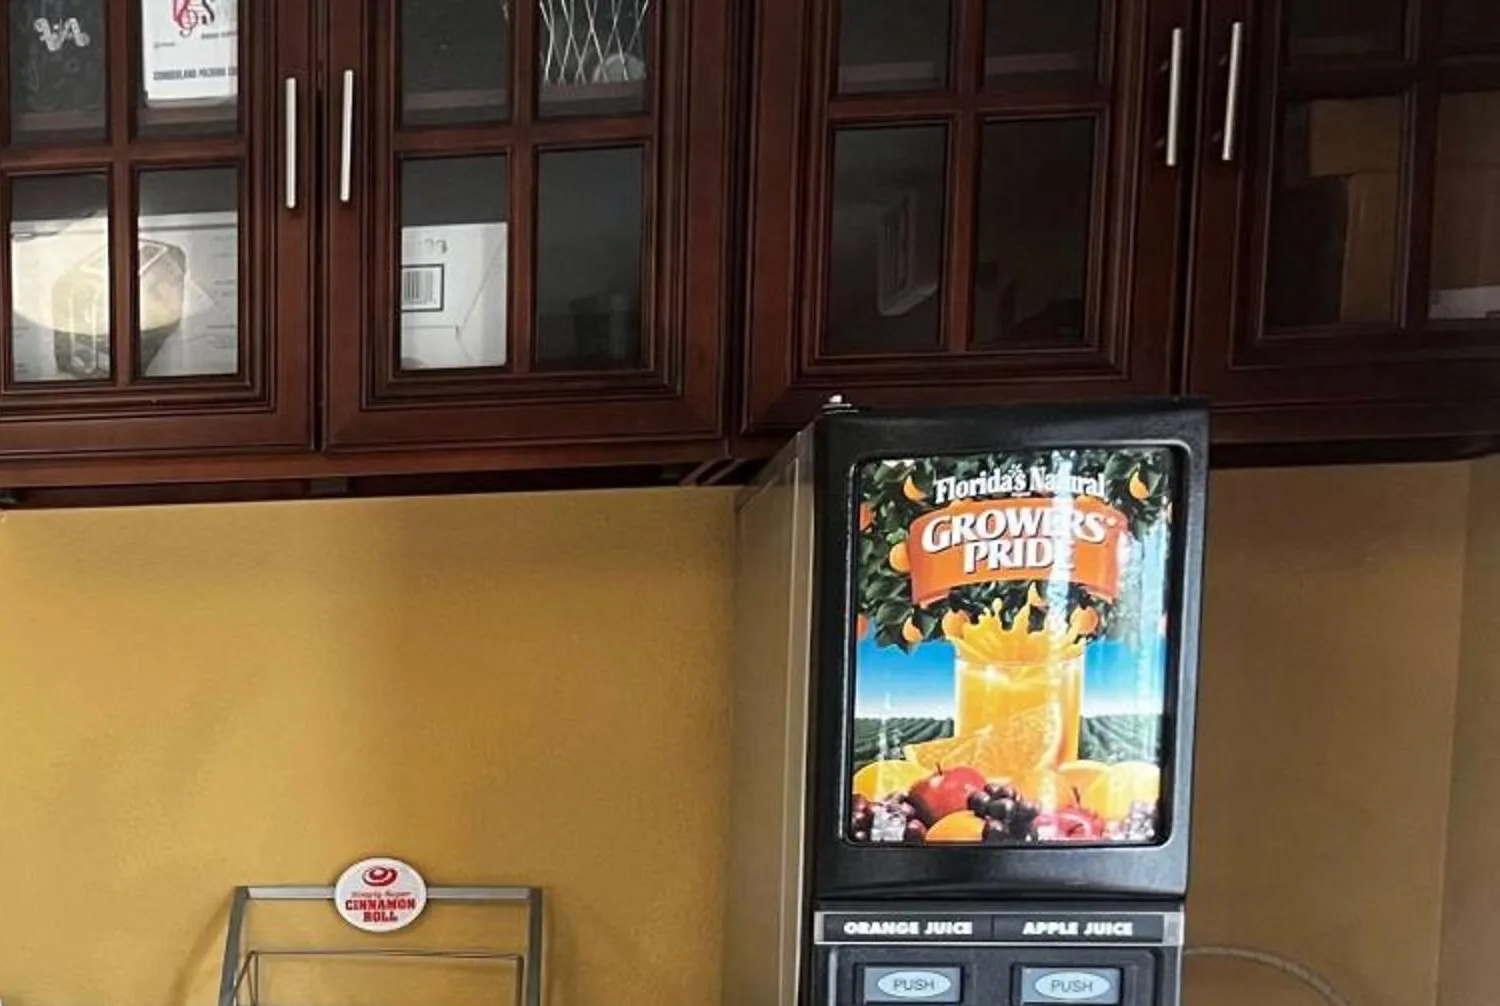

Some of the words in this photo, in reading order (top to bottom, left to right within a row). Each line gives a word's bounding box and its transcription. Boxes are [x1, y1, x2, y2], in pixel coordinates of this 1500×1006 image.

[1030, 466, 1106, 498] Naural
[345, 898, 416, 911] CINNAMON
[363, 911, 398, 923] ROLL
[844, 921, 919, 936] ORANGE
[924, 921, 973, 936] JUICE
[1022, 921, 1078, 936] APPLE
[1084, 921, 1133, 936] JUICE
[893, 978, 935, 991] PUSH
[1050, 979, 1093, 992] PUSH
